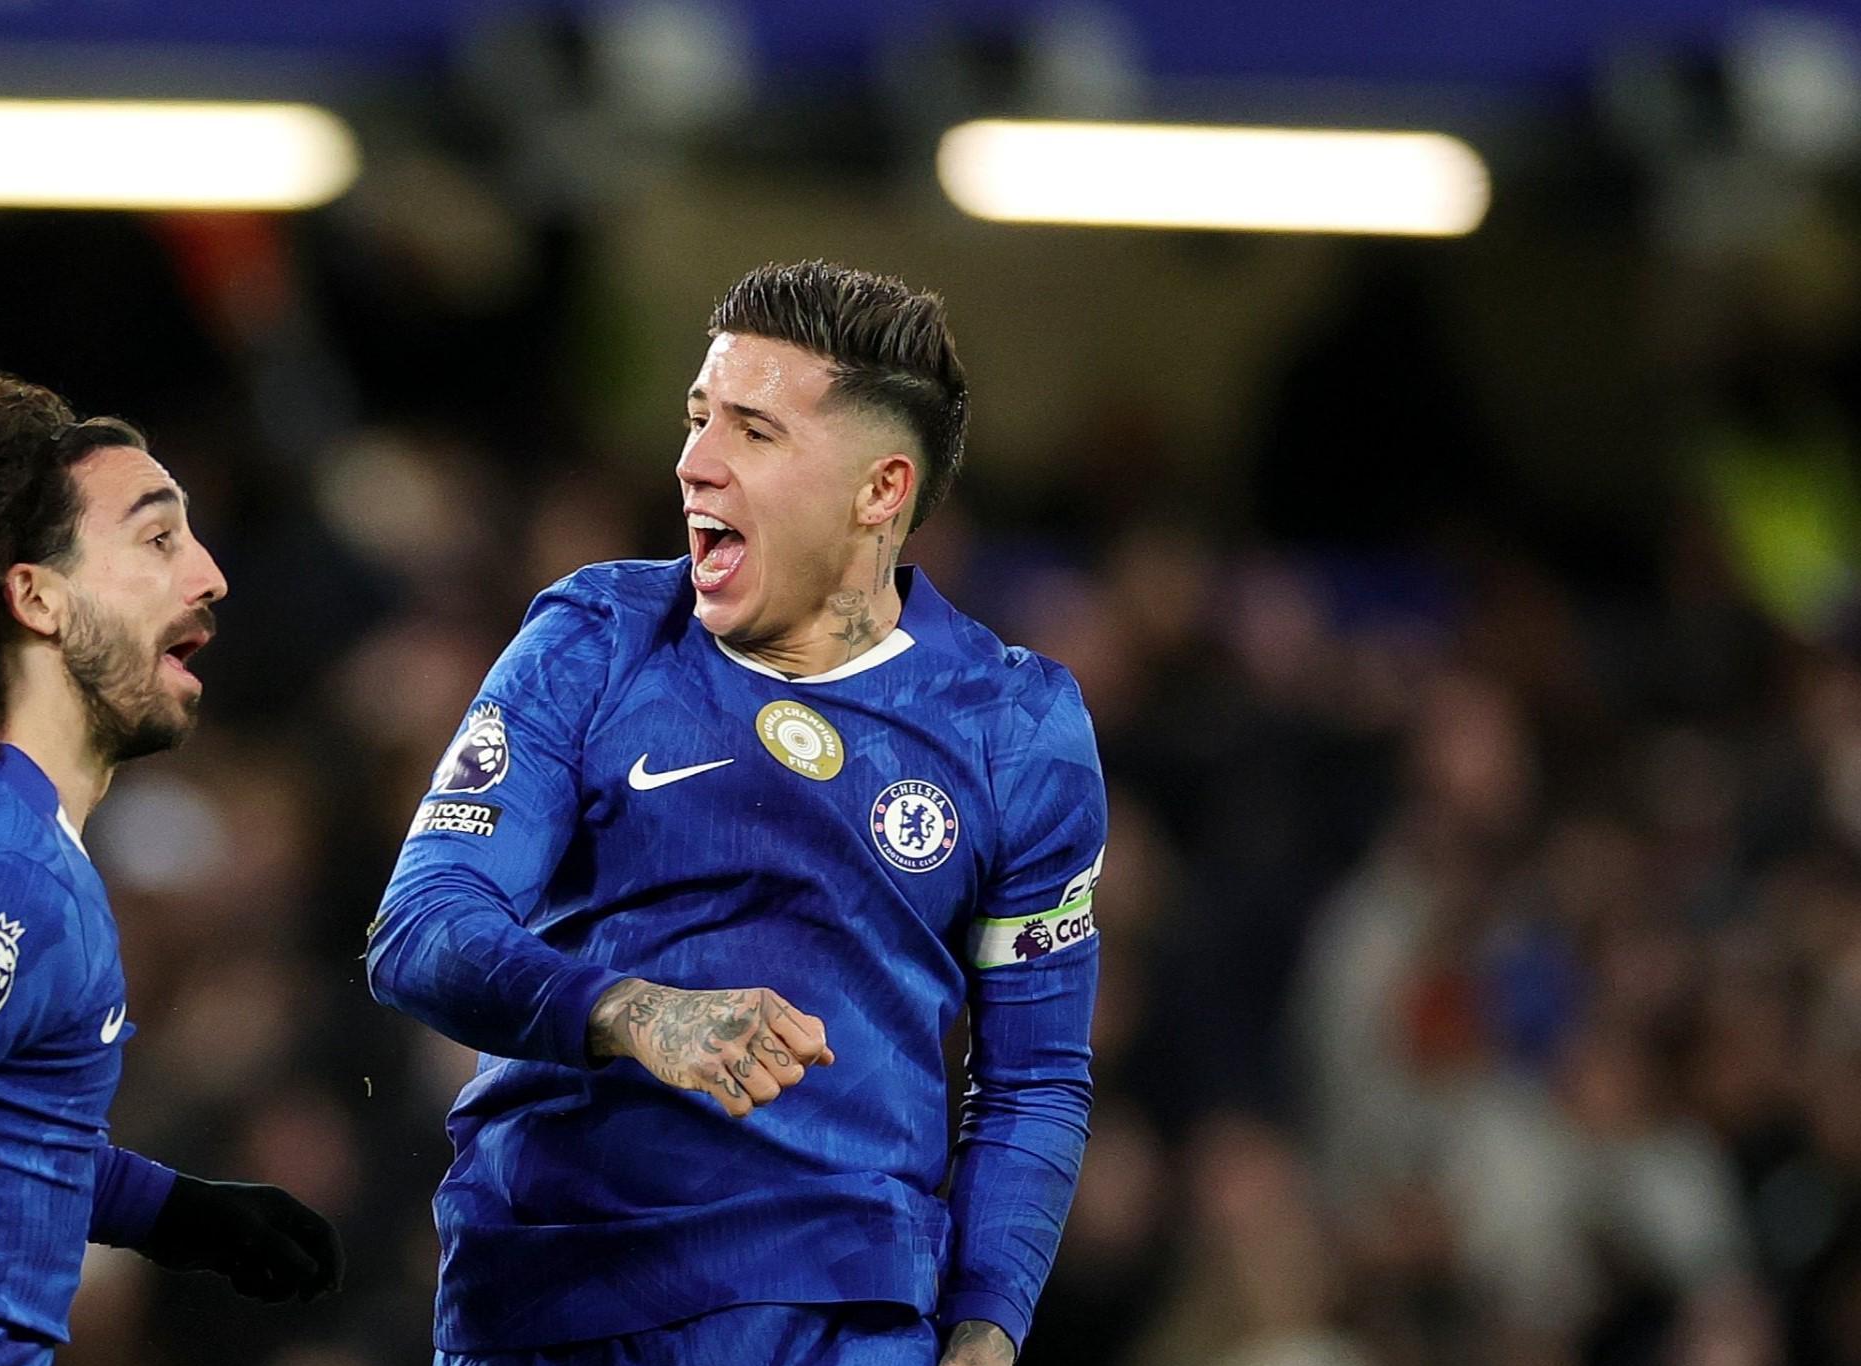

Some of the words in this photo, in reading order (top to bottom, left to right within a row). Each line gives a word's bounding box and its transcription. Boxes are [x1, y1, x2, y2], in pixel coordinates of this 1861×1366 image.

[788, 755, 820, 775] FIFA
[890, 783, 946, 809] CHELSEA
[435, 803, 491, 822] room
[428, 817, 494, 837] racism
